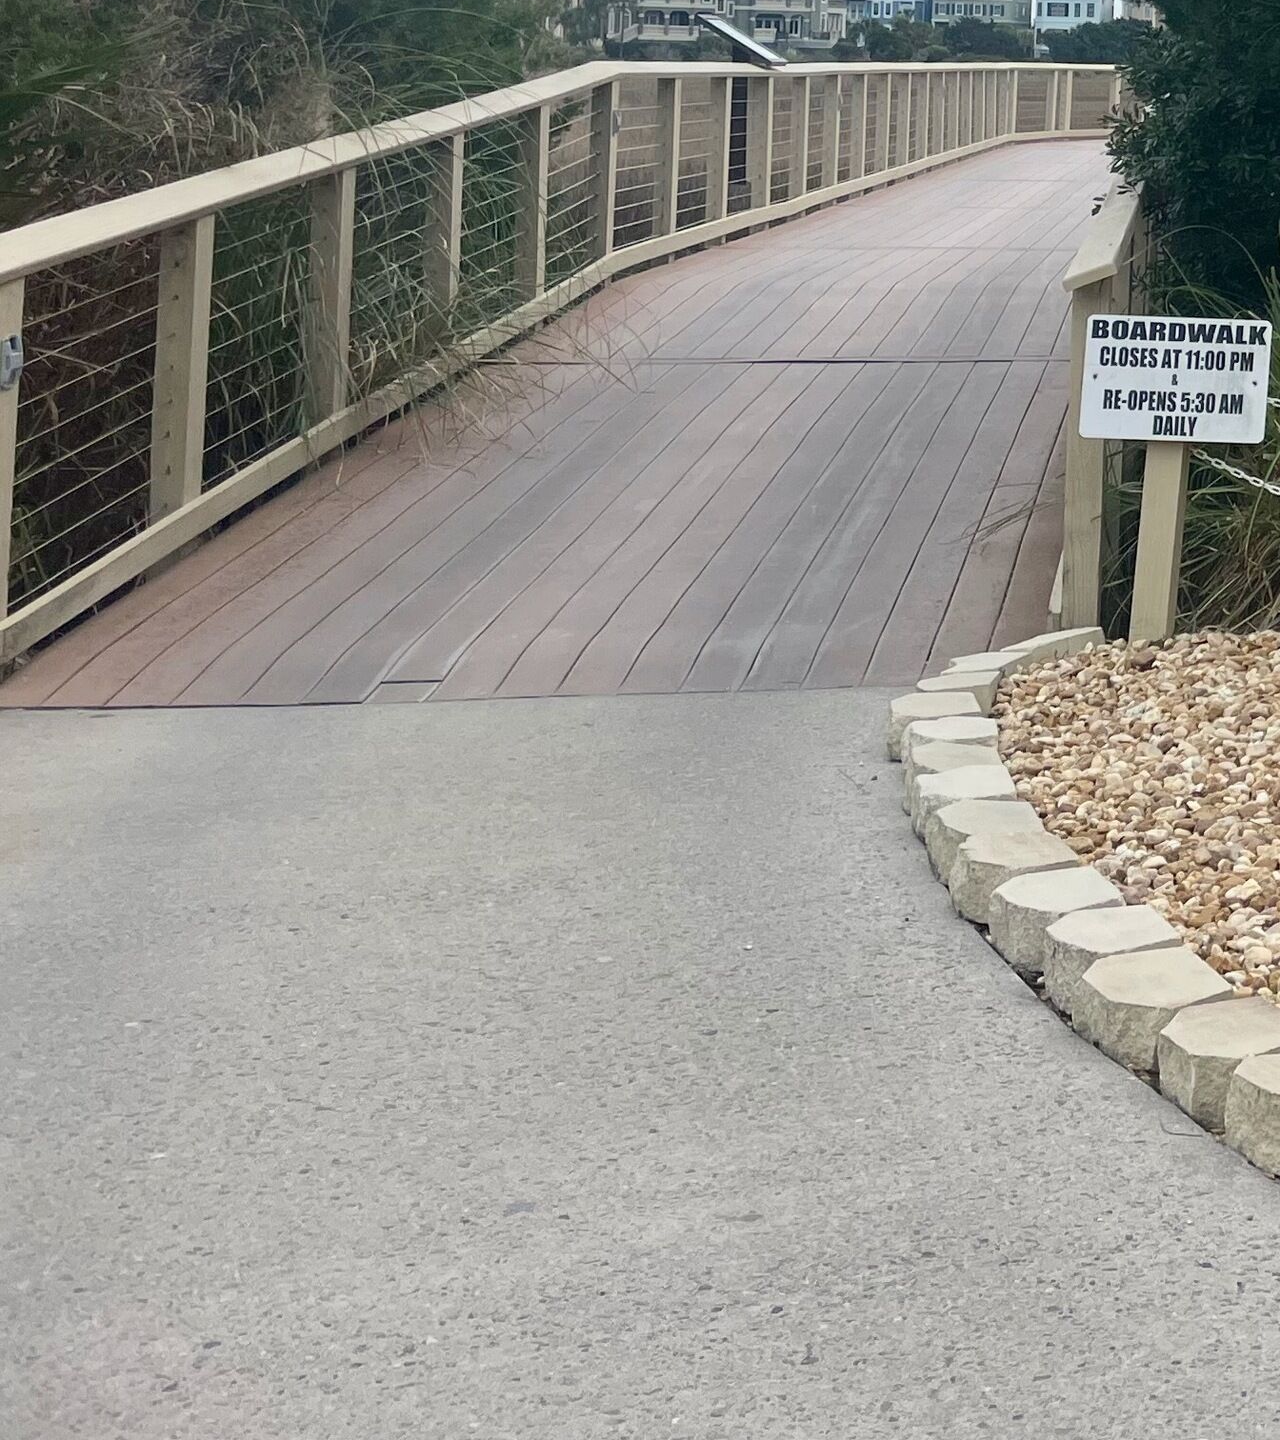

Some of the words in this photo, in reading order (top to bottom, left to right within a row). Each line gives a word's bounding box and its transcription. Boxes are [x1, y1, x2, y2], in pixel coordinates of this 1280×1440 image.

[1091, 319, 1267, 345] BOARDWALK
[1099, 346, 1159, 368] CLOSES
[1161, 349, 1182, 369] AT
[1185, 350, 1226, 371] 11:00
[1230, 351, 1254, 372] PM
[1171, 374, 1178, 386] &
[1103, 389, 1177, 412] RE-OPENS
[1180, 392, 1216, 414] 5:30
[1219, 394, 1244, 415] AM
[1152, 415, 1198, 437] DAILY
